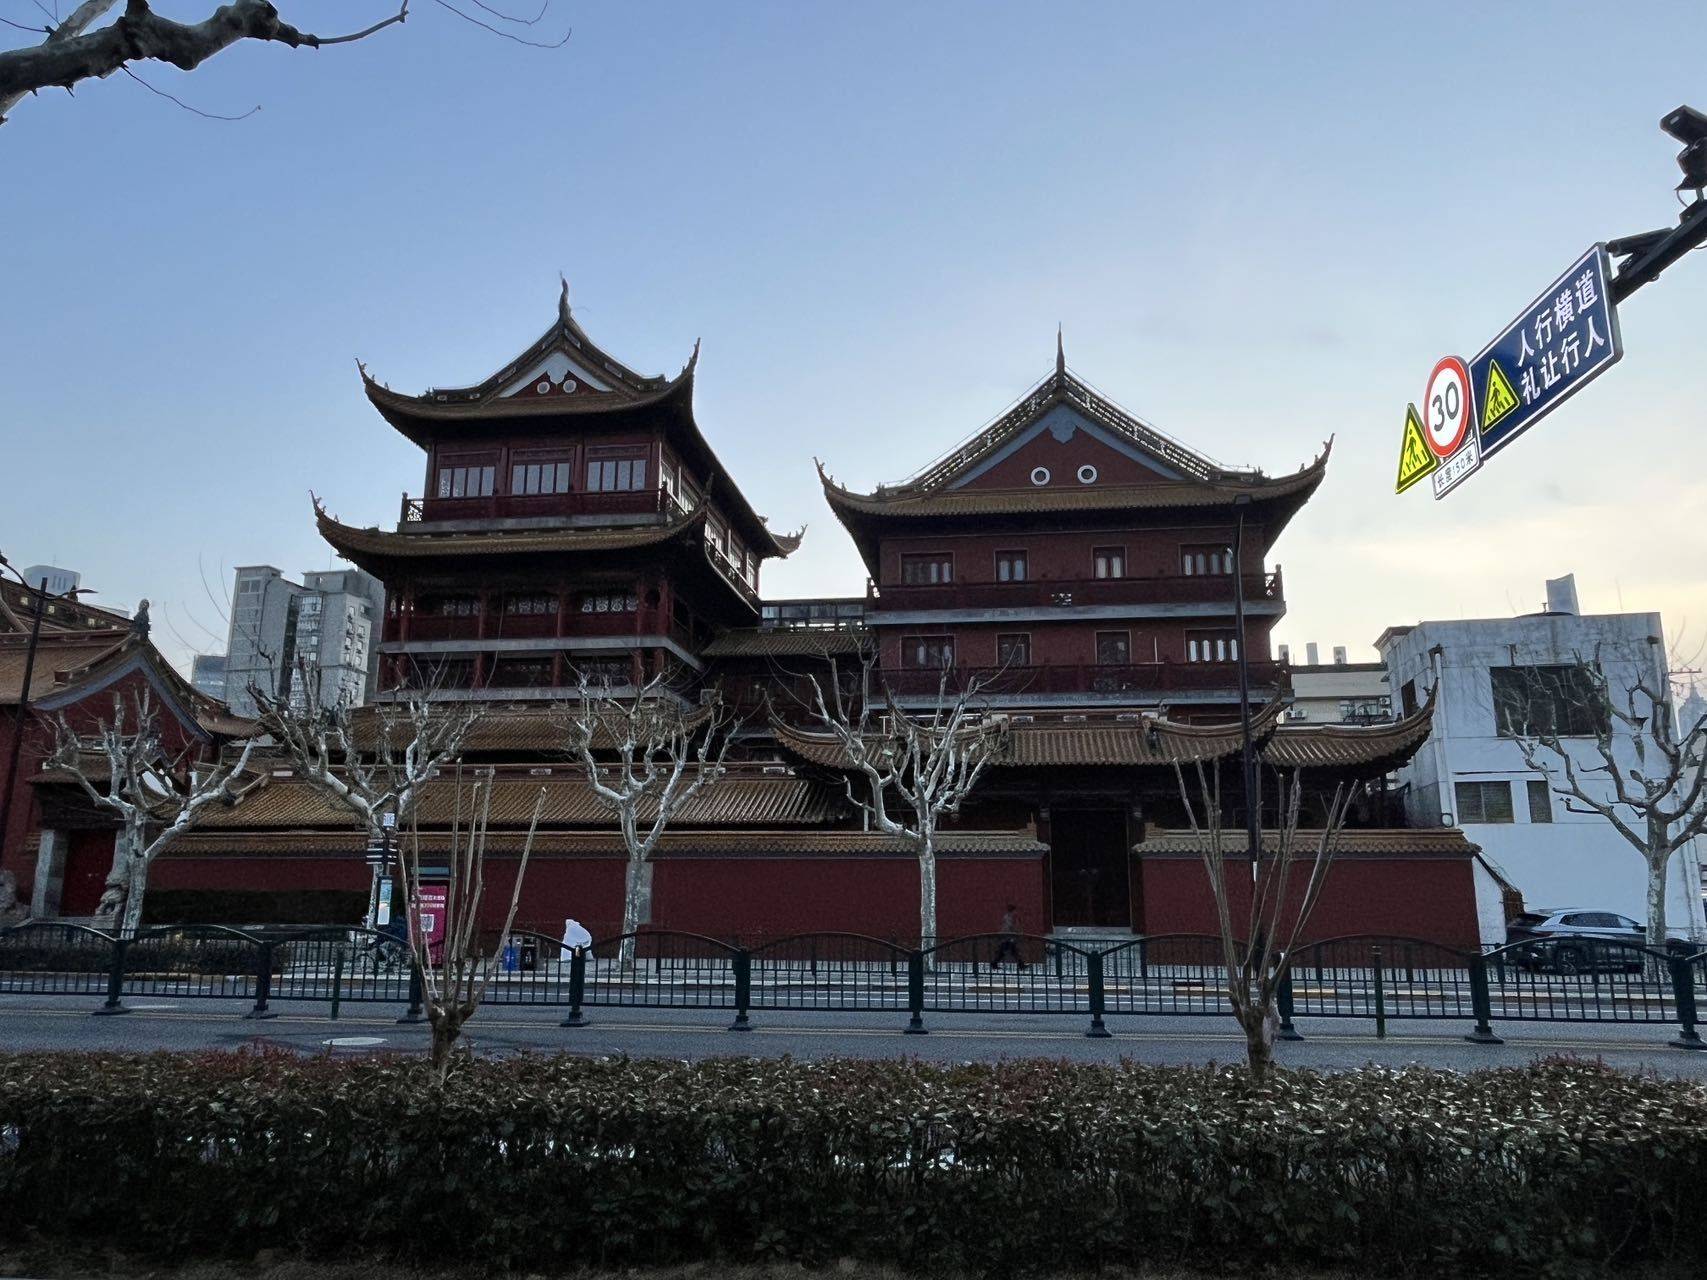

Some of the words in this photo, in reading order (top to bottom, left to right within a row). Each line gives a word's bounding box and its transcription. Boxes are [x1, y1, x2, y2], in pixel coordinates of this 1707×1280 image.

[1517, 269, 1598, 367] 人行横道
[1521, 315, 1605, 405] 礼让行人
[1431, 381, 1460, 432] 30
